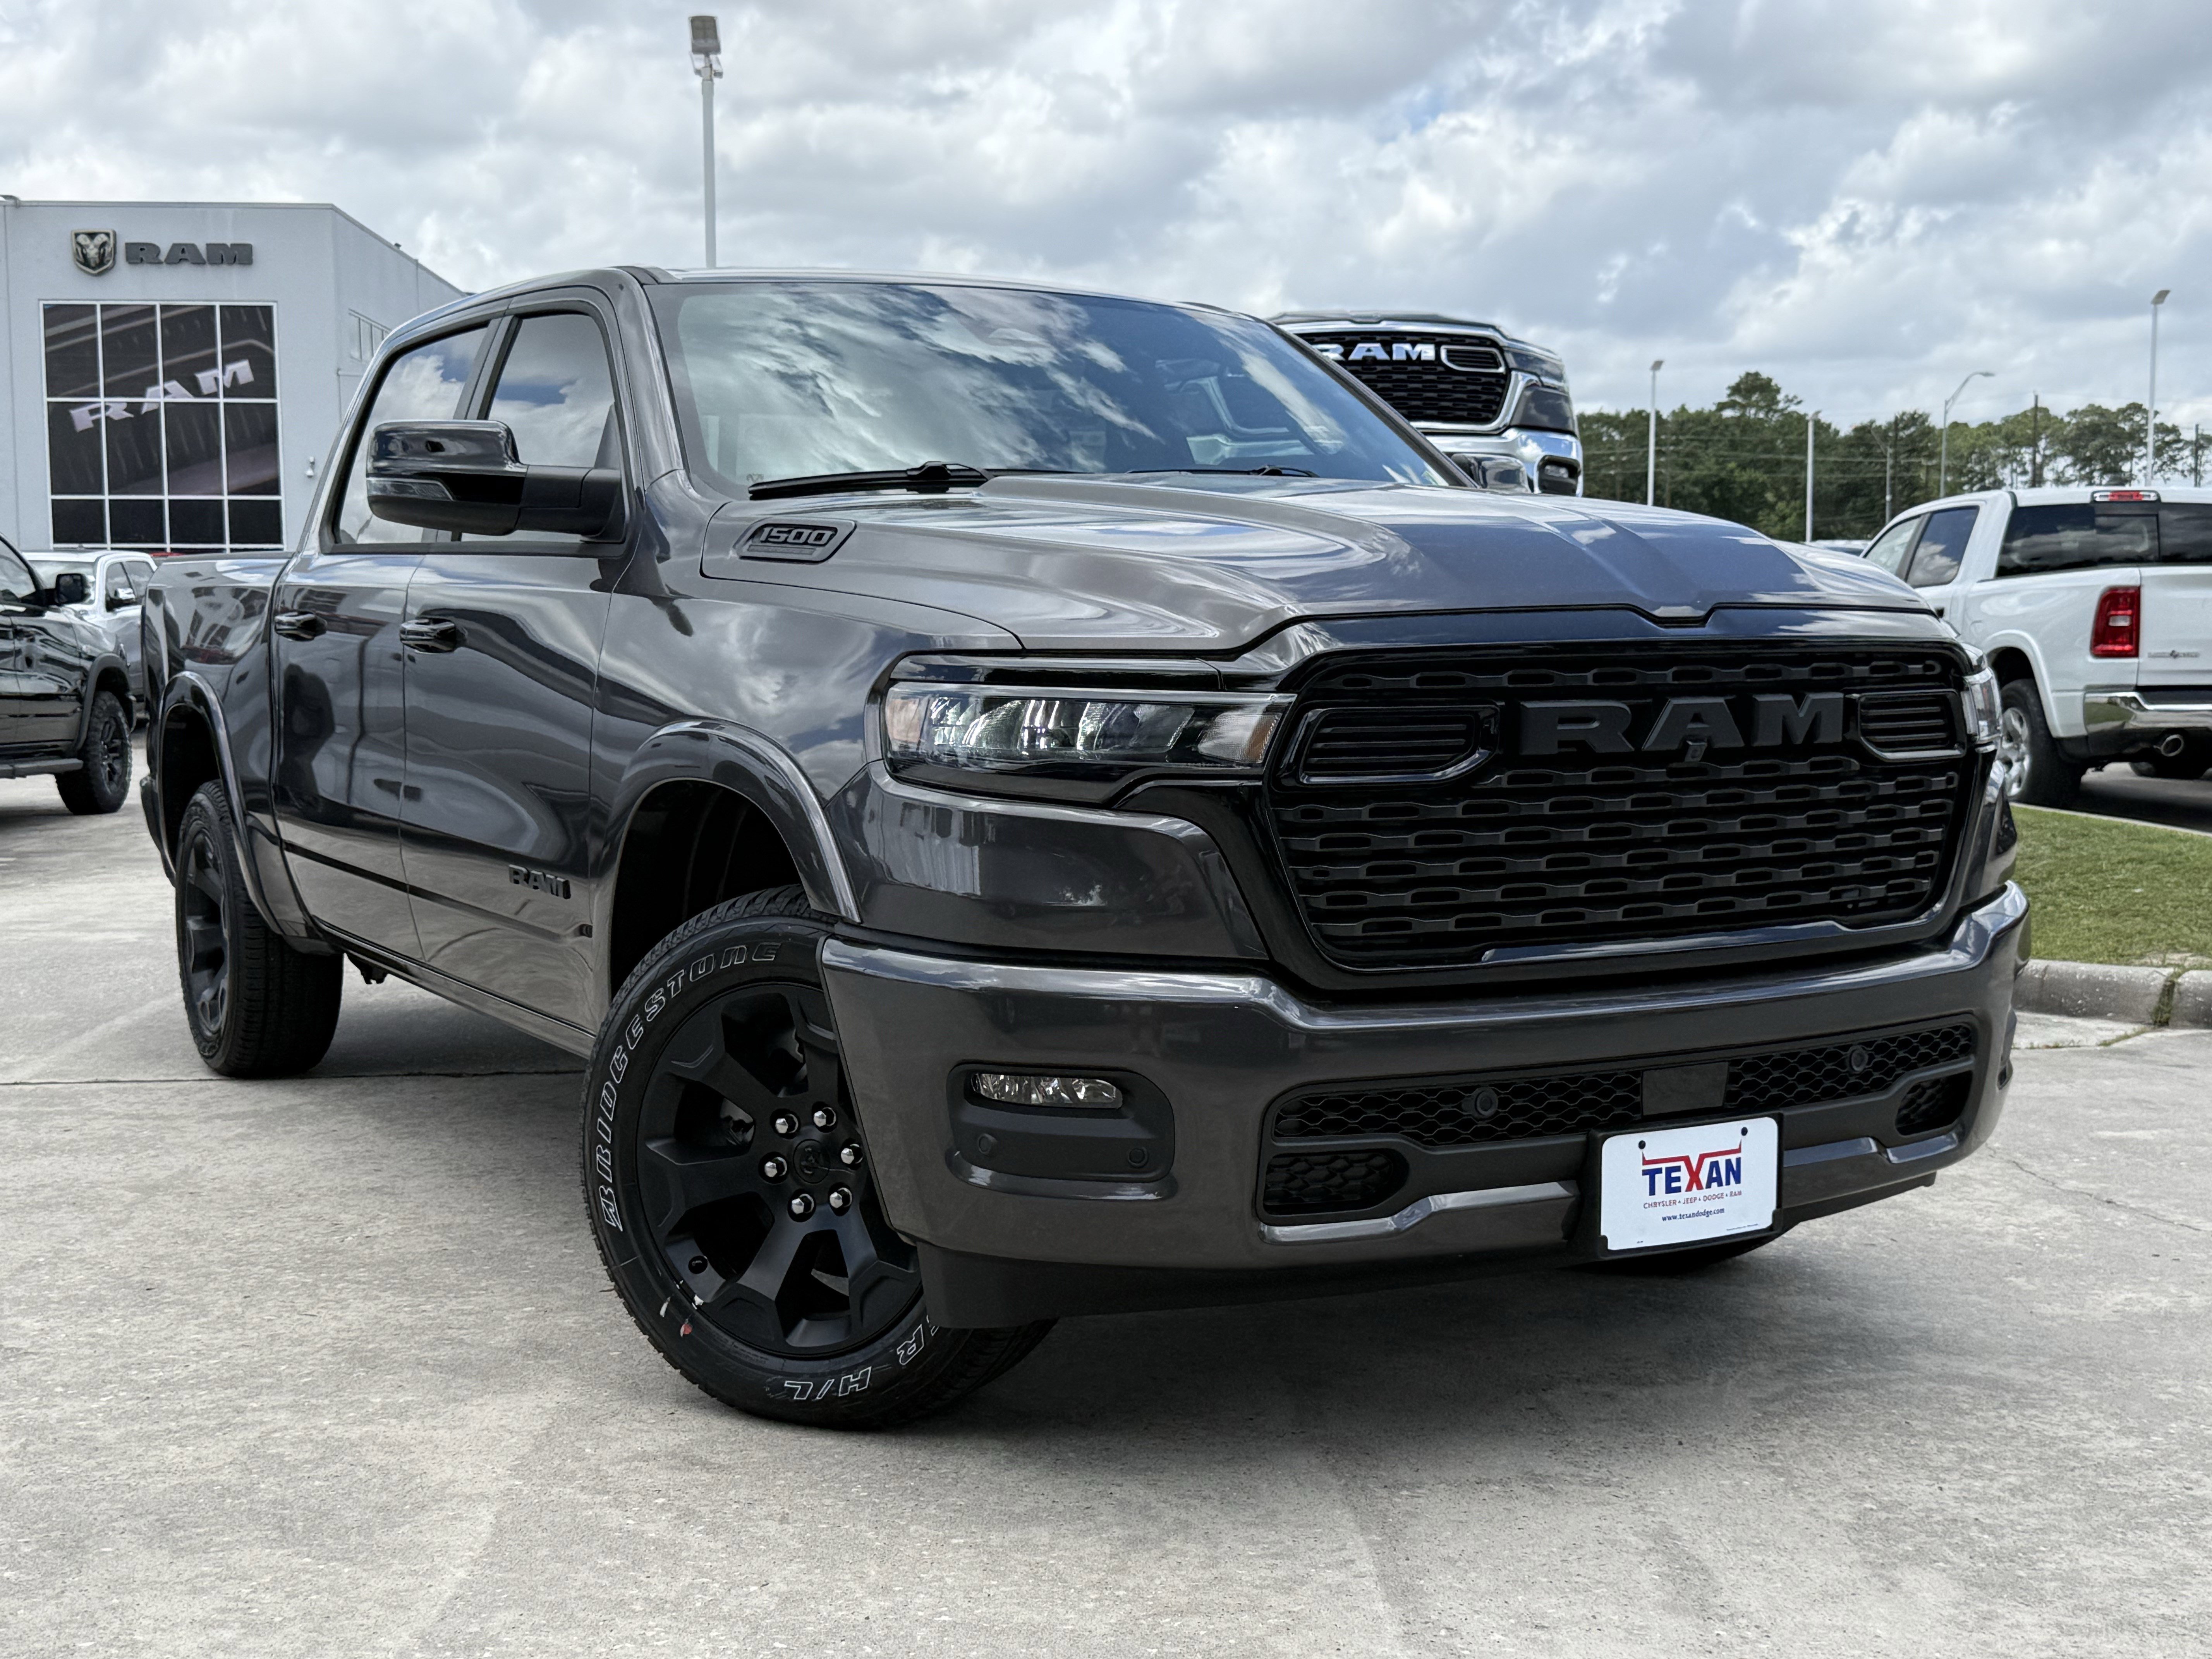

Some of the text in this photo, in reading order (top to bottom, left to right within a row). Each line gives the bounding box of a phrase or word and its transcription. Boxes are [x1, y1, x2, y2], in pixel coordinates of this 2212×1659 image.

[125, 242, 252, 264] RAM
[1310, 343, 1435, 361] RAM
[70, 359, 254, 433] RAM
[760, 527, 833, 545] 1500
[1520, 693, 1844, 755] RAM
[508, 864, 571, 900] RAM
[596, 942, 782, 1232] BRIDGESTONE
[1642, 1154, 1741, 1196] TEXAN
[1643, 1199, 1676, 1209] CHRYSLER
[1703, 1192, 1724, 1202] DODGE
[1662, 1208, 1725, 1221] www.texandodge.com
[784, 1366, 872, 1400] H/L
